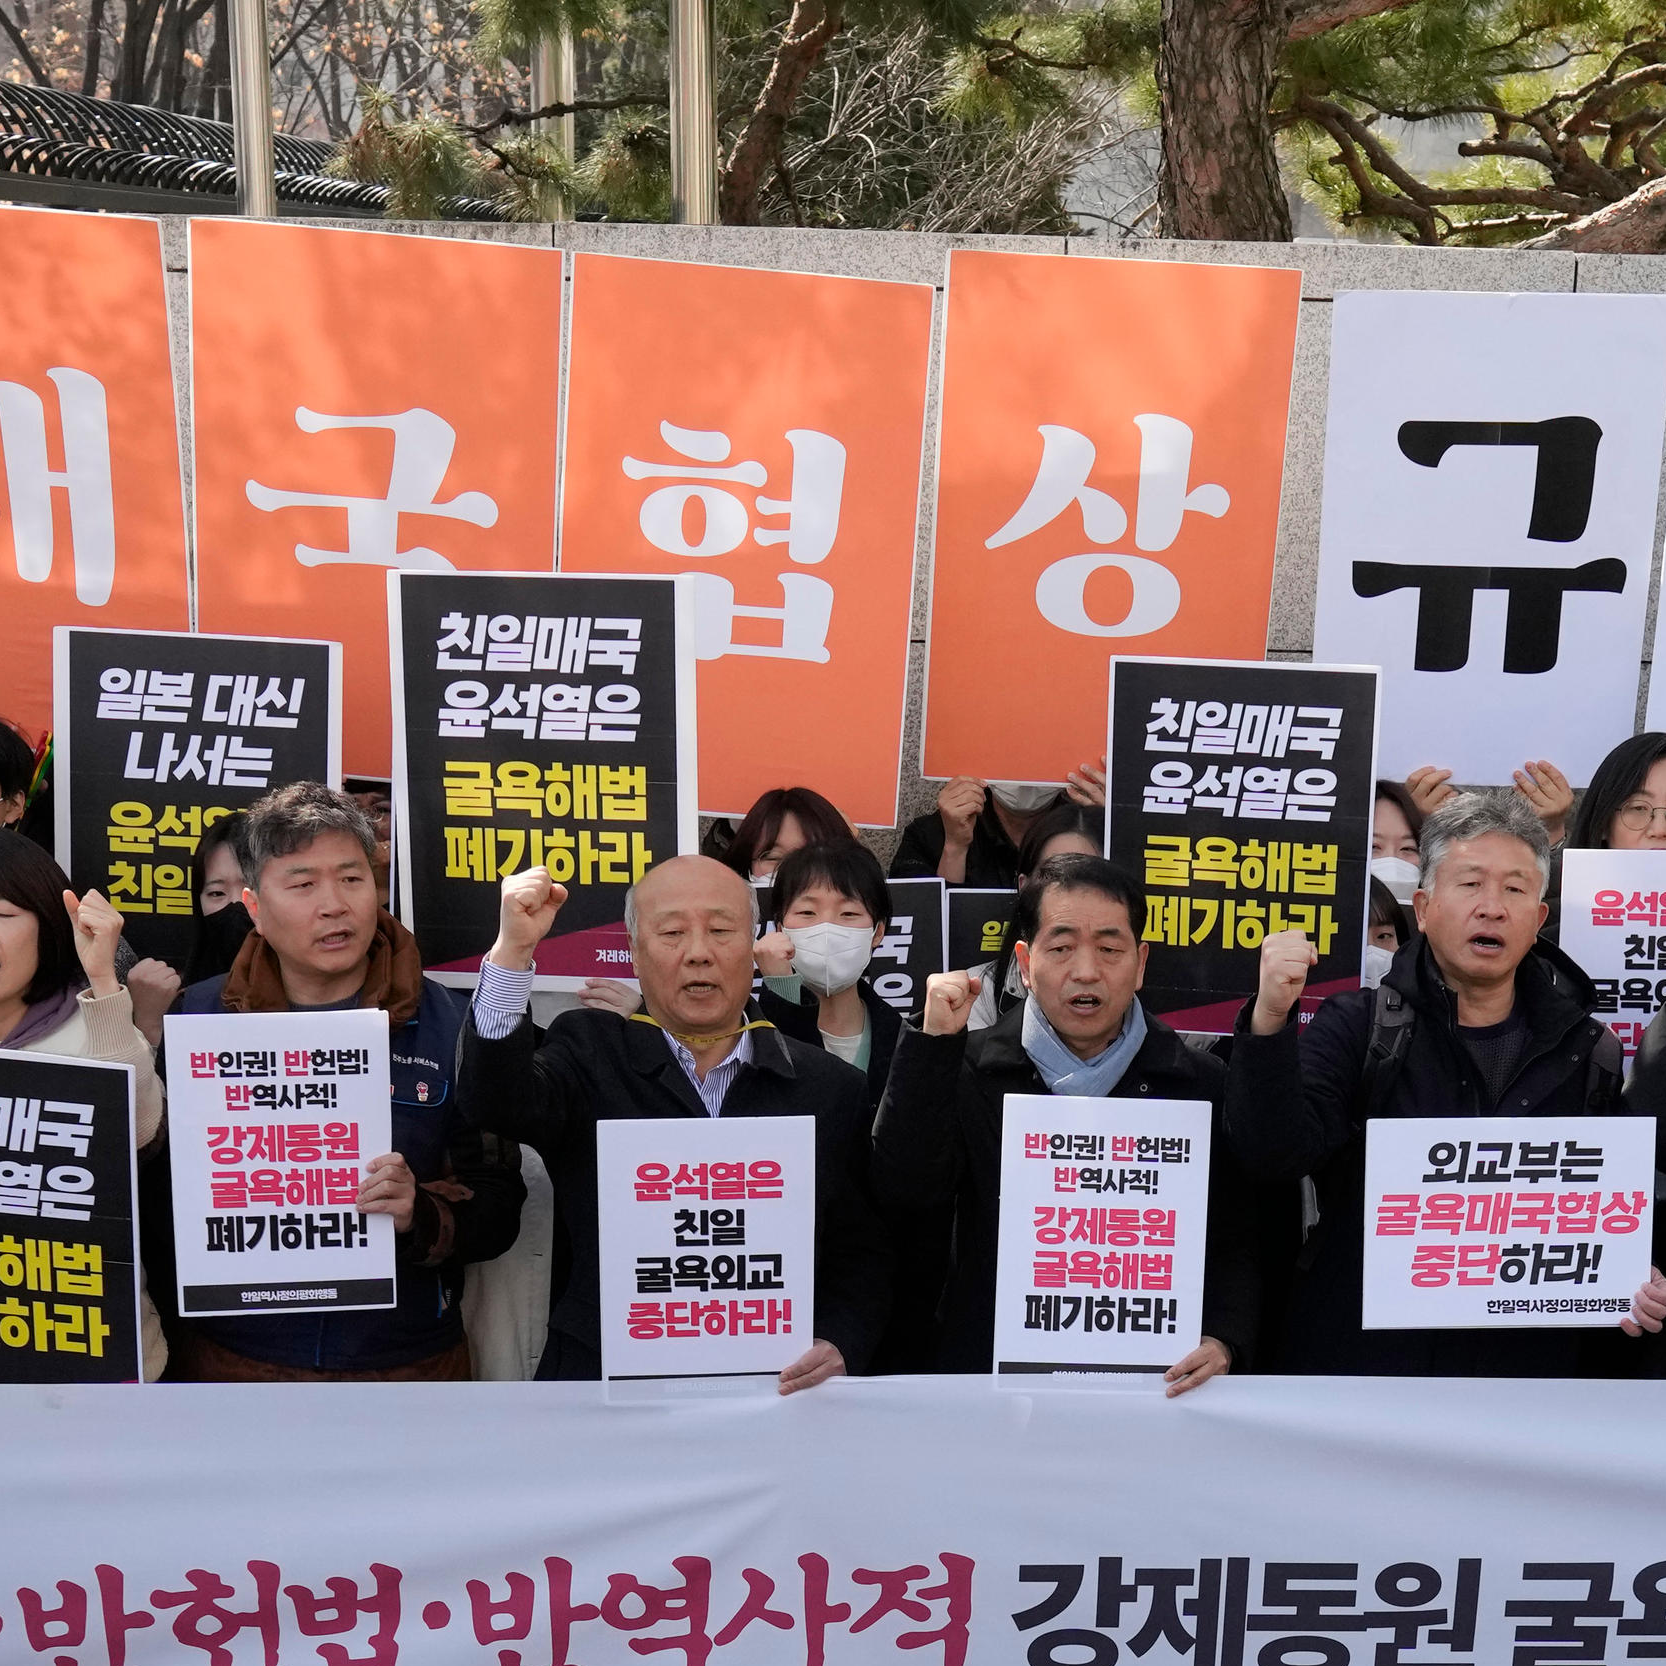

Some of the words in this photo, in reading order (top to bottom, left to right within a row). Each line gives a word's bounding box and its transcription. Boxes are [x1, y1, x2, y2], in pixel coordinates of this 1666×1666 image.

[985, 413, 1230, 637] 상
[1352, 416, 1627, 674] 규
[437, 612, 642, 674] 친일매국
[97, 668, 194, 722] 일본
[202, 675, 305, 728] 대신
[438, 681, 641, 741] 윤석열은
[1145, 698, 1343, 760] 친일매국
[124, 732, 272, 787] 나서는
[443, 761, 646, 820] 굴욕해법
[1143, 761, 1337, 822] 윤석열은
[444, 827, 652, 885] 폐기하라
[1144, 835, 1338, 895] 굴욕해법
[1141, 895, 1338, 956] 폐기하라
[596, 950, 633, 964] 겨레하
[191, 1051, 276, 1078] 반인권!
[284, 1049, 368, 1076] 반헌법!
[226, 1083, 337, 1111] 반역사적!
[207, 1123, 359, 1164] 강제동원
[1025, 1134, 1104, 1160] 반인권!
[1112, 1136, 1190, 1163] 반헌법!
[1422, 1141, 1604, 1183] 외교부는
[211, 1168, 360, 1210] 굴욕해법
[634, 1161, 784, 1201] 윤석열은
[1055, 1167, 1158, 1194] 반역사적!
[206, 1212, 368, 1252] 폐기하라!
[674, 1209, 745, 1247] 친일
[1034, 1207, 1176, 1246] 강제동원
[1376, 1192, 1647, 1236] 굴욕매국협상
[635, 1254, 784, 1293] 굴욕외교
[1033, 1251, 1172, 1290] 굴욕해법
[1412, 1243, 1603, 1287] 중단하라!
[241, 1289, 337, 1302] 한일역사정의평화행동
[1025, 1295, 1177, 1334] 폐기하라!
[1487, 1299, 1631, 1313] 한일역사정의평화행동
[627, 1299, 791, 1339] 중단하라!
